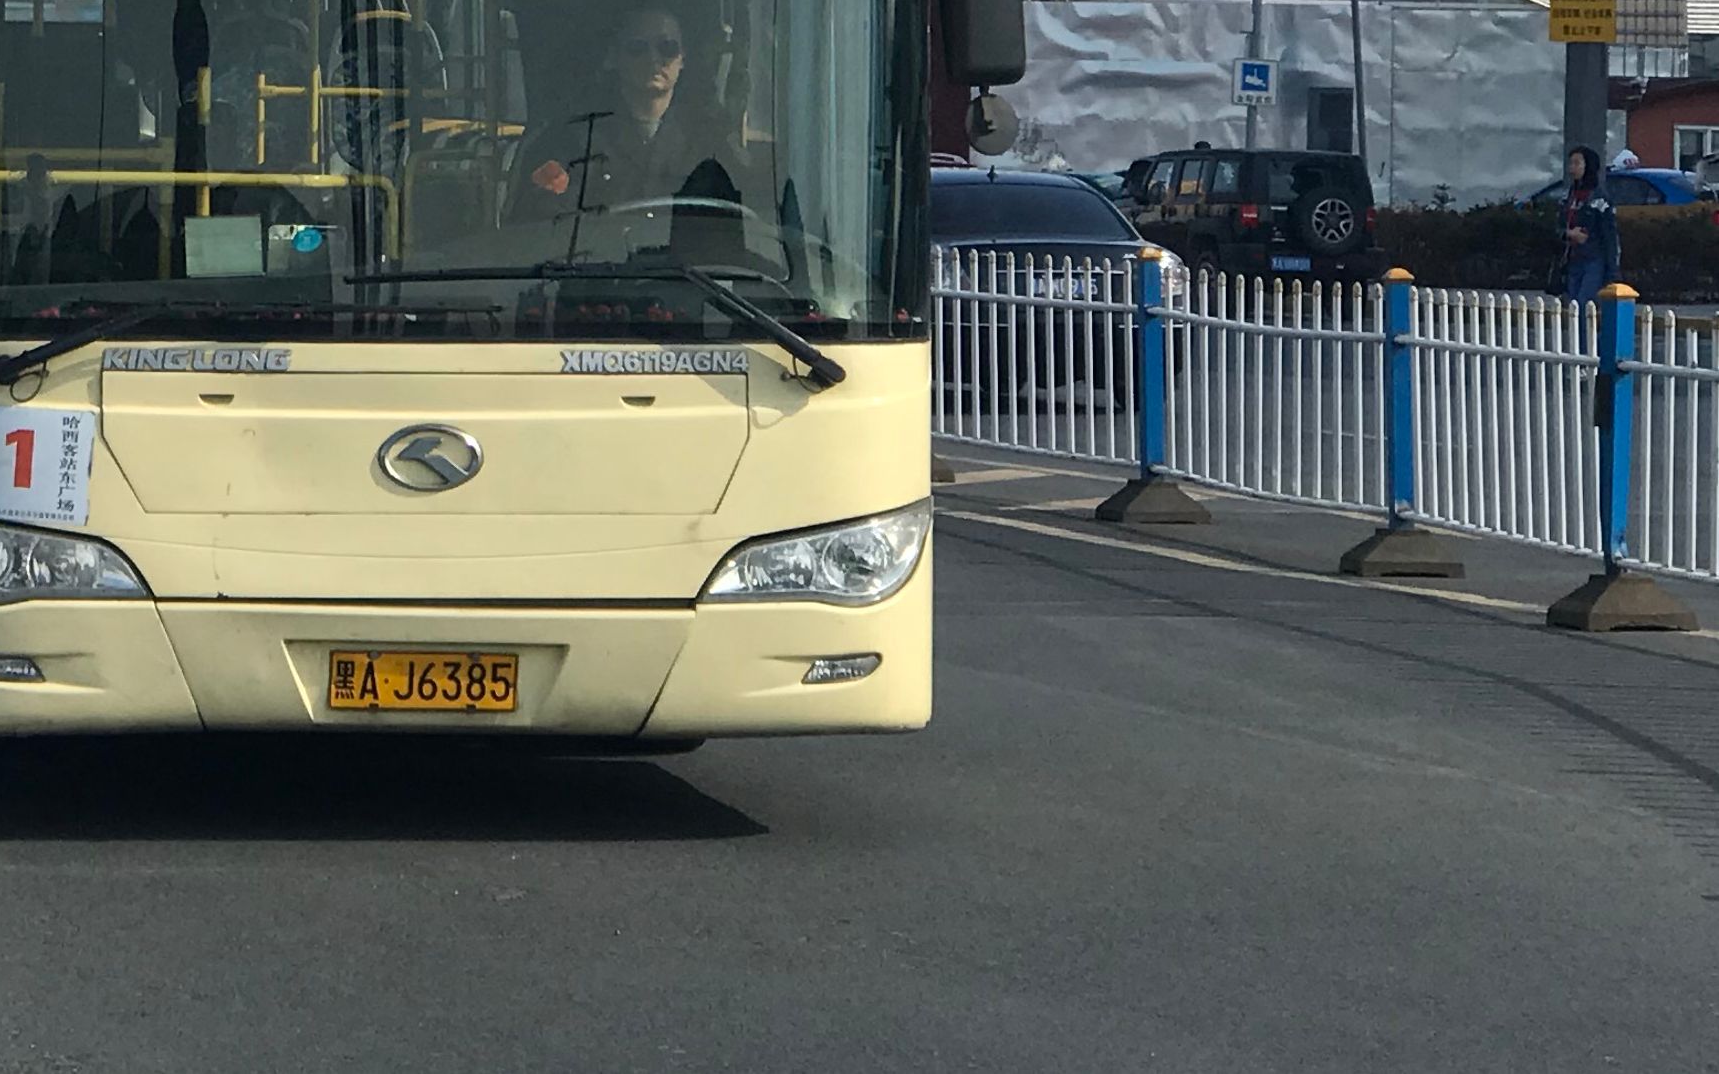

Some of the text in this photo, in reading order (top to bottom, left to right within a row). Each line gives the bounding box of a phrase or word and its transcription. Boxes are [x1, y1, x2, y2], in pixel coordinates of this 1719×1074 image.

[561, 350, 749, 373] XMQ6119AGN4
[56, 415, 81, 512] 哈西客站东广场
